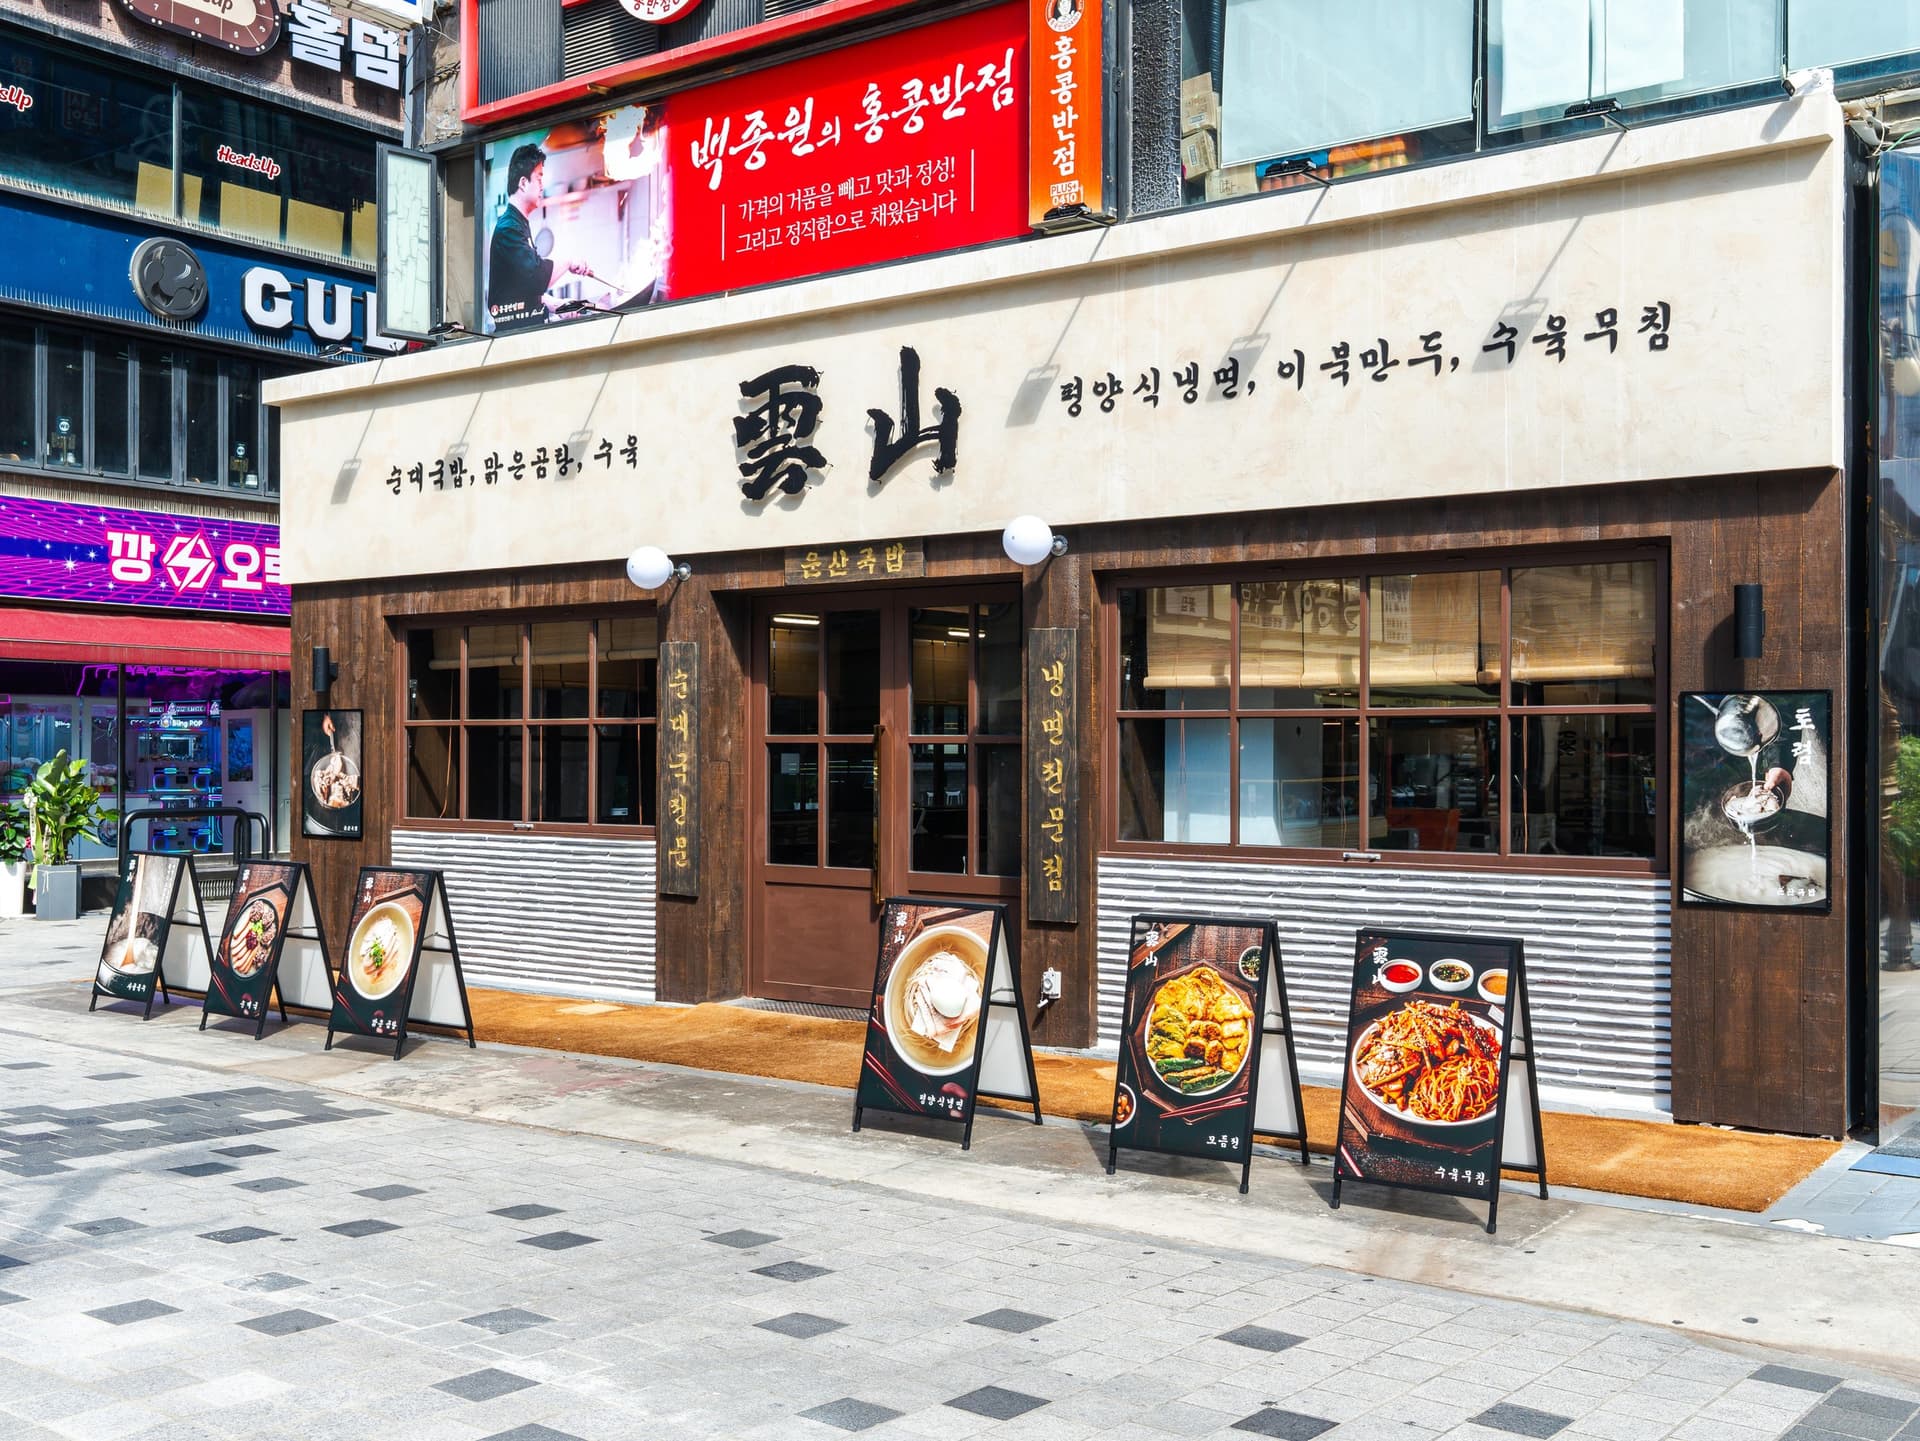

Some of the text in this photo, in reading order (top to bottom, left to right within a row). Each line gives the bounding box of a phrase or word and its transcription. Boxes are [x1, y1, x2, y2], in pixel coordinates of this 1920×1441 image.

[690, 47, 1015, 191] 백종원의 홍콩반점
[1050, 35, 1079, 177] 홍콩반점
[217, 144, 281, 180] HeadsUp
[738, 156, 956, 223] 가격의 거품을 빼고 맛과 정성!
[1051, 183, 1077, 195] PLUS+
[736, 189, 958, 254] 그리고 정직함으로 채웠습니다
[1052, 193, 1077, 206] 0410
[1060, 301, 1672, 418] 평양식냉면, 이북만두, 수육무침
[733, 345, 962, 500] 雲山
[386, 456, 475, 496] 순대국밥,
[593, 434, 639, 470] 수육
[107, 531, 156, 583] 깡
[801, 542, 906, 579] 운산국밥
[668, 668, 691, 869] 순대국전문
[1041, 660, 1065, 892] 냉면전문점
[920, 1092, 964, 1110] 평양식냉면
[1434, 1166, 1485, 1186] 수육무침
